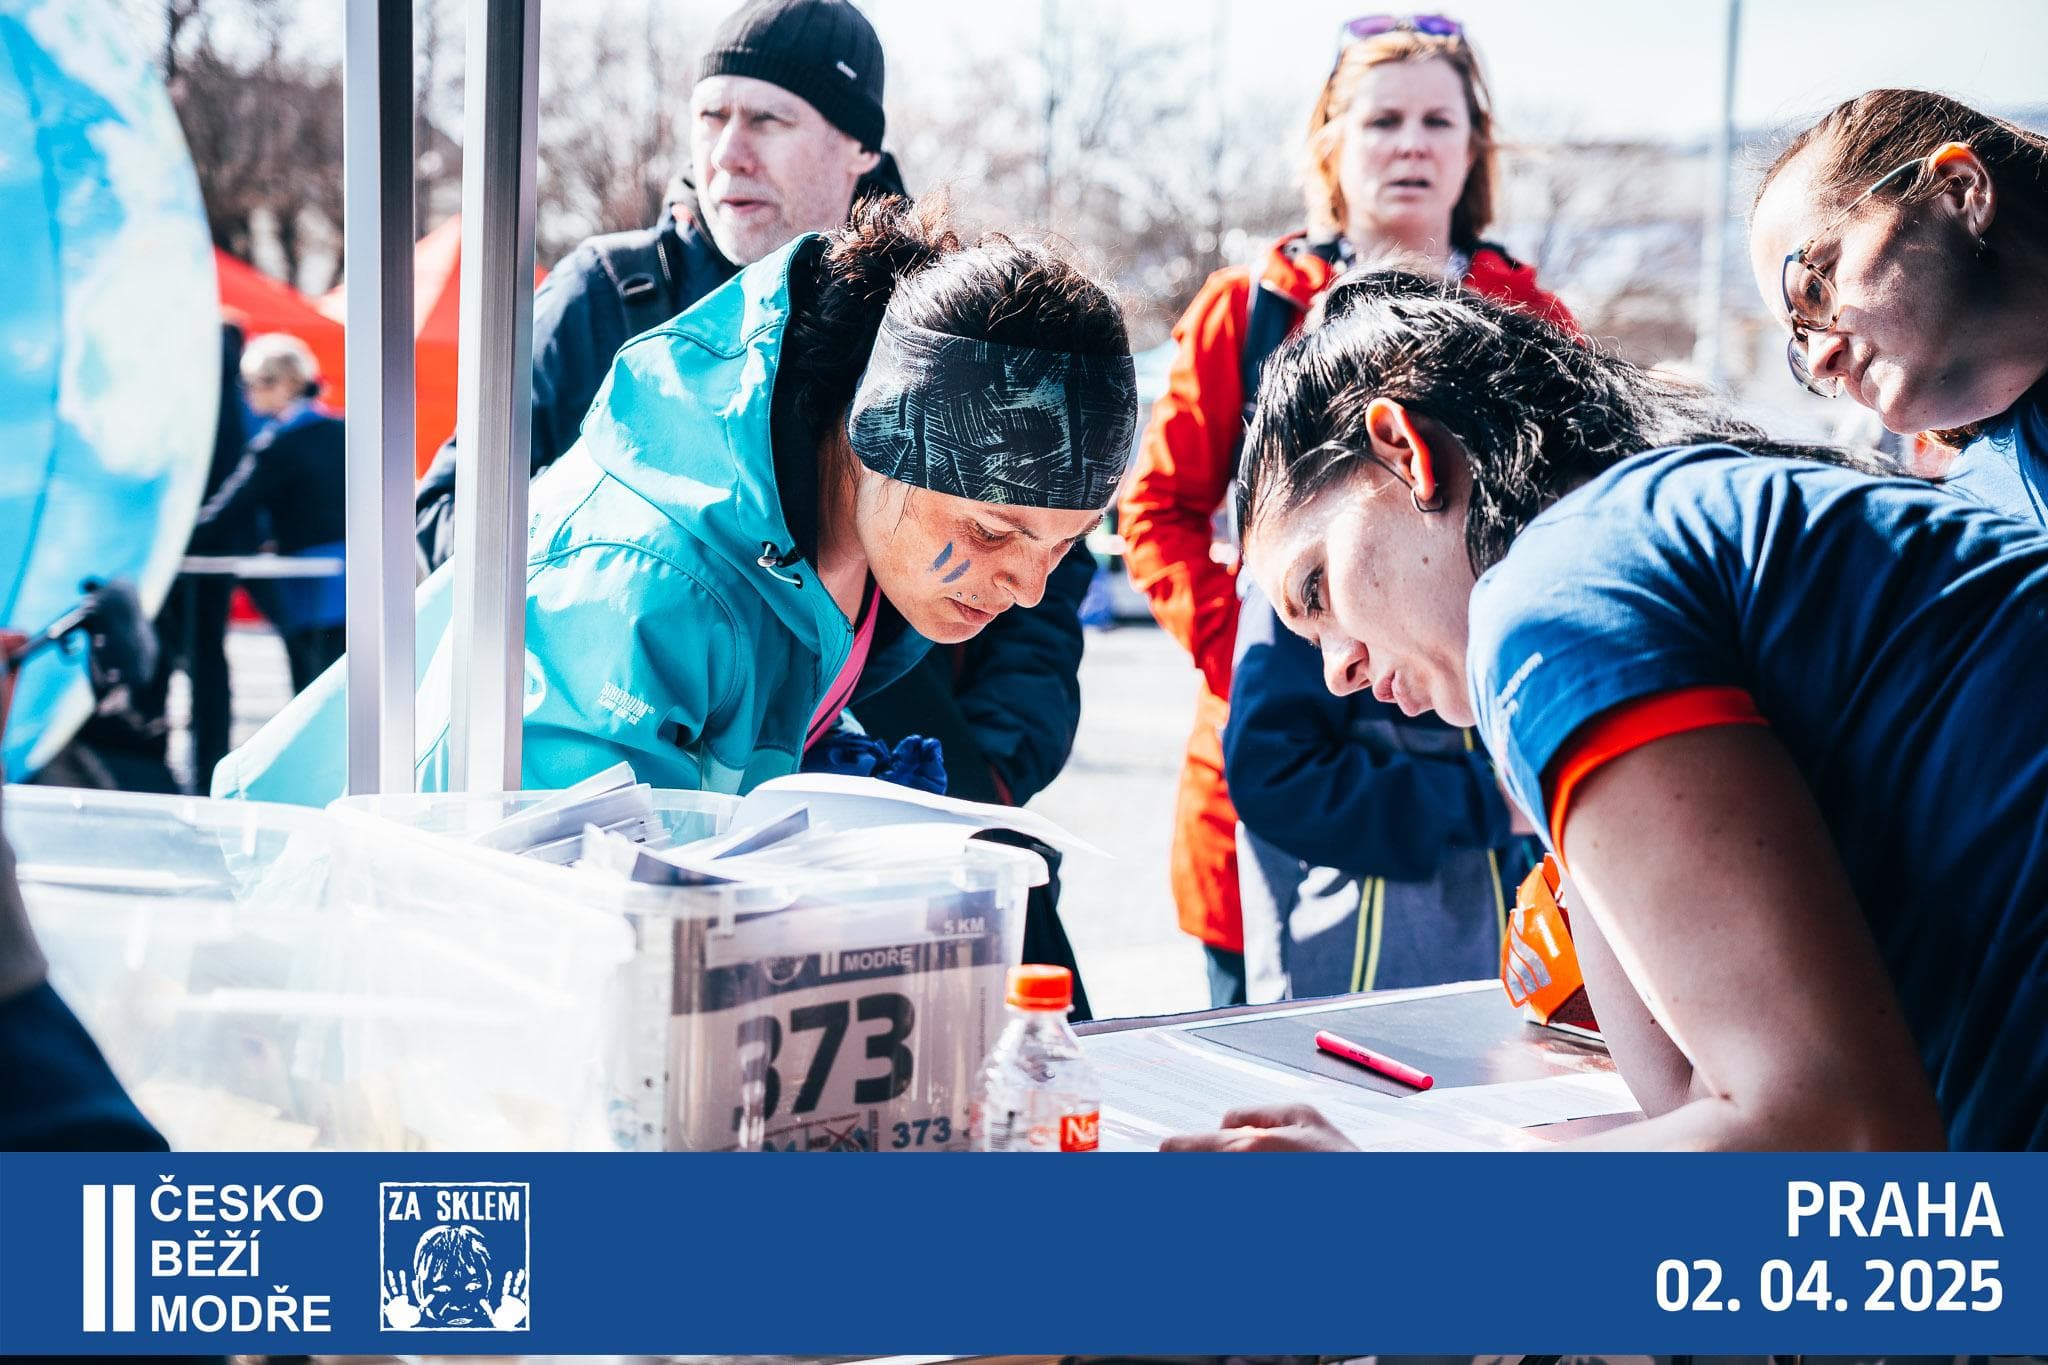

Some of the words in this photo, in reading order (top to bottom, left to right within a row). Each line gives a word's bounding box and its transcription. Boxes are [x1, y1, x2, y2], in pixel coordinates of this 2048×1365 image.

[943, 920, 954, 935] 5
[957, 917, 986, 934] KM
[732, 993, 915, 1132] 373
[892, 1115, 952, 1149] 373
